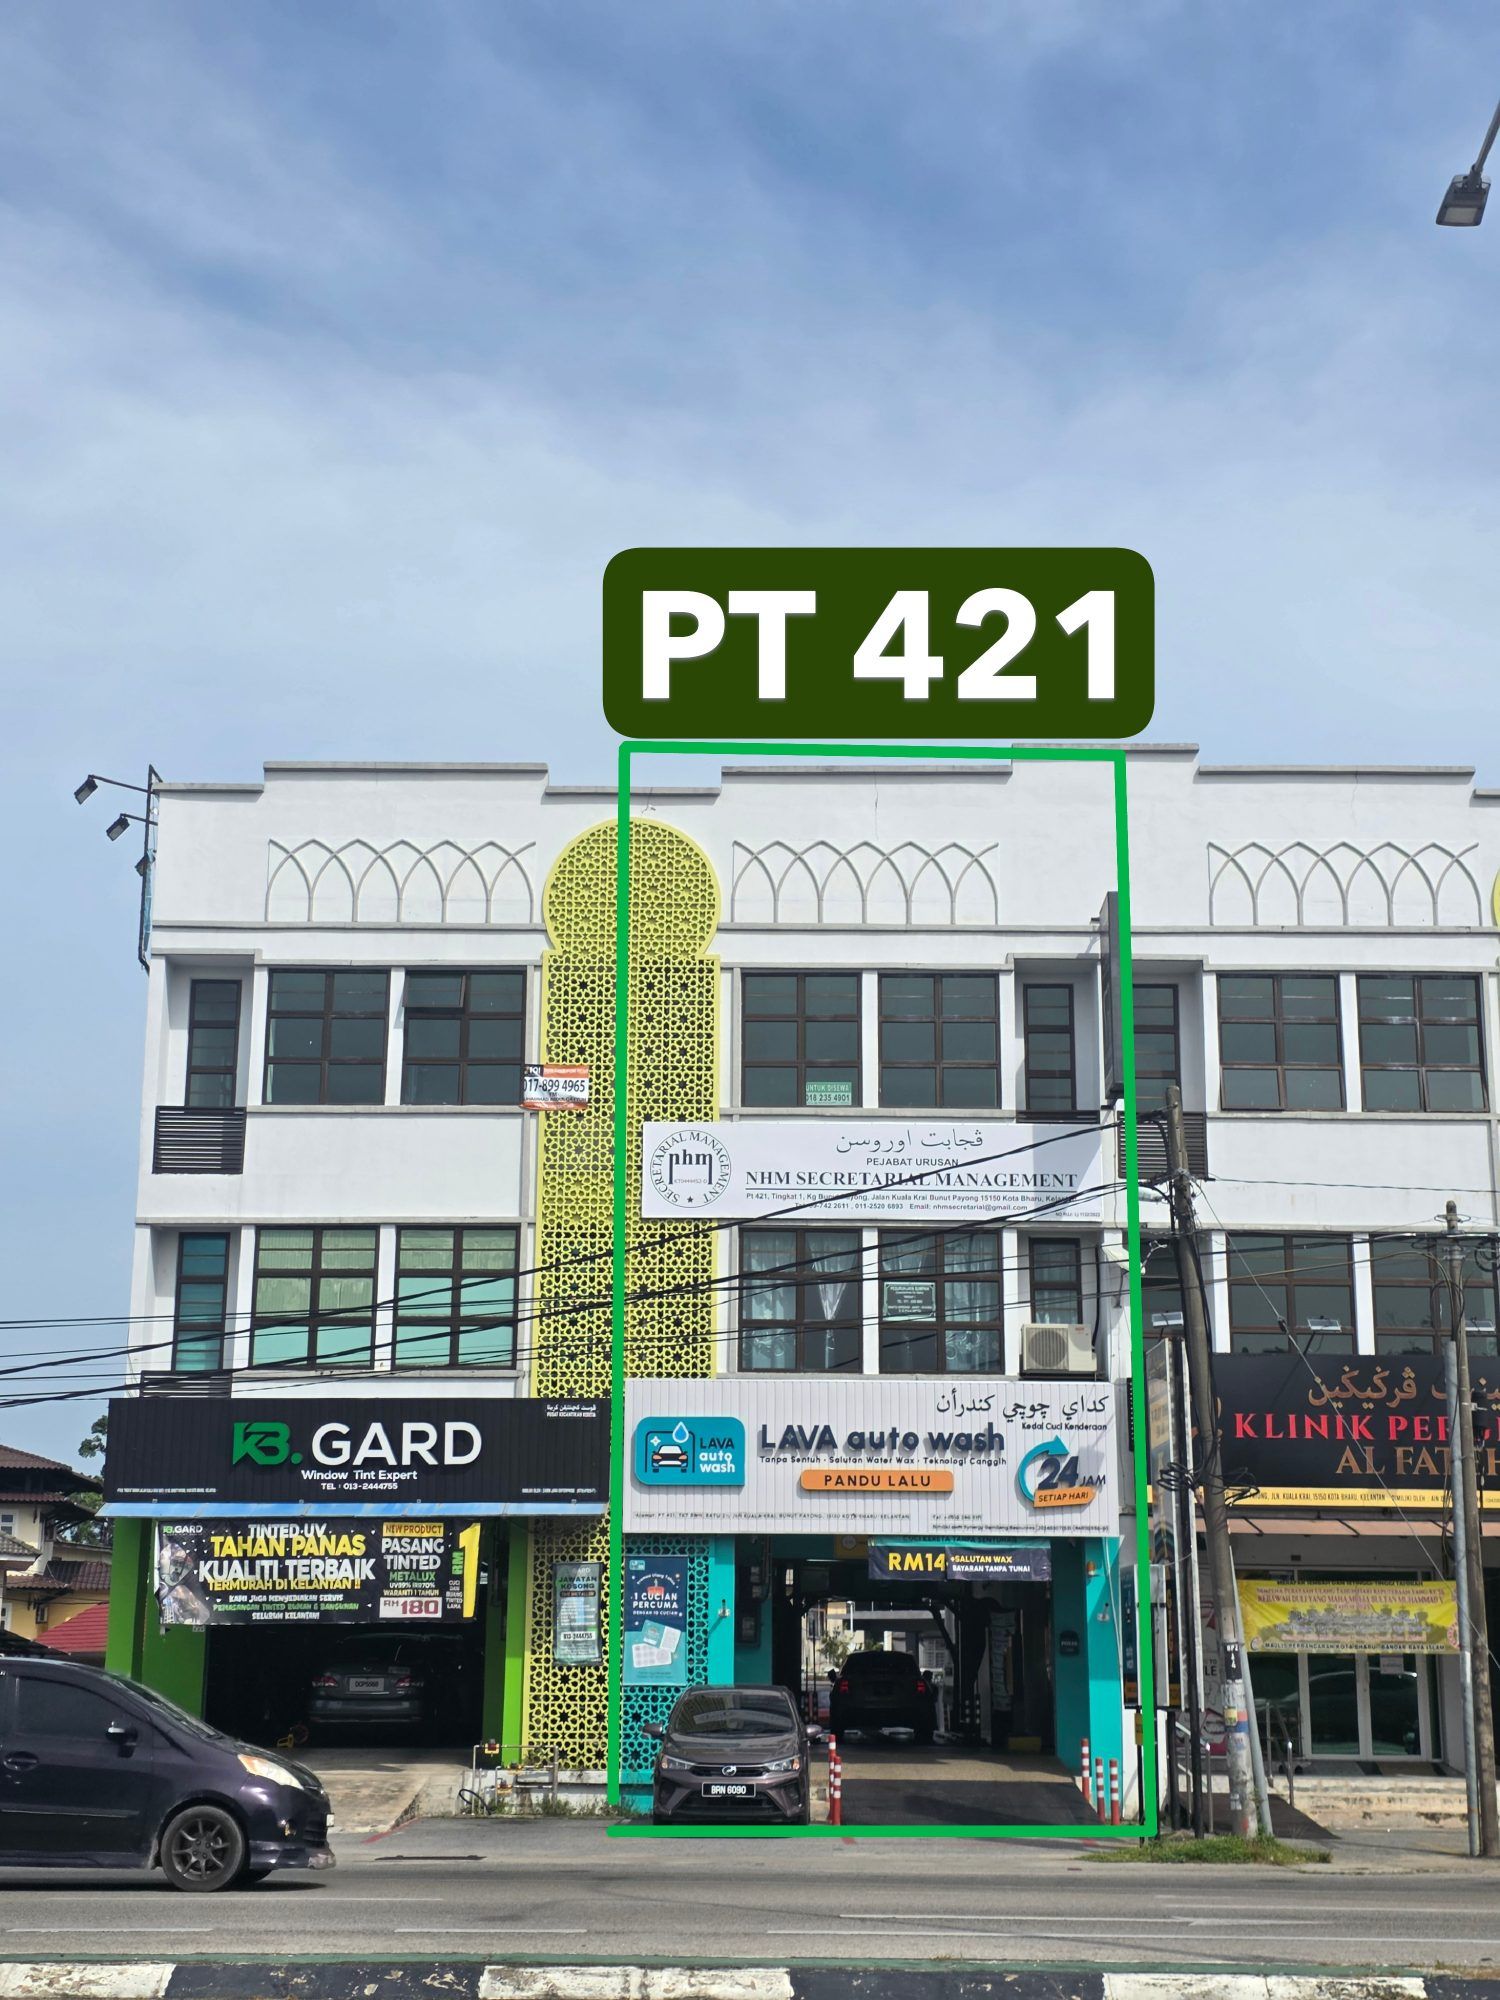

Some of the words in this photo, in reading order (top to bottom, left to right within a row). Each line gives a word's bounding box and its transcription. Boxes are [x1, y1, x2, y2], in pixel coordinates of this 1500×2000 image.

[562, 1080, 586, 1092] 4965
[652, 1132, 687, 1204] SECRETARIAL
[689, 1131, 730, 1204] MANAGEMENT
[866, 1158, 912, 1166] PEJABAT
[916, 1158, 958, 1166] URUSAN
[746, 1172, 790, 1184] NHM
[796, 1172, 930, 1186] SECRETARIAL
[936, 1172, 1078, 1188] MANAGEMENT
[772, 1193, 797, 1201] Tingkat
[806, 1194, 816, 1202] Kg
[1062, 1395, 1109, 1420] كداي
[1022, 1422, 1044, 1430] Kedai
[1046, 1422, 1062, 1430] Cuci
[1064, 1422, 1108, 1431] Kenderaan
[1234, 1413, 1375, 1440] KLINIK
[762, 1424, 838, 1450] LAVA
[849, 1427, 920, 1450] auto
[928, 1422, 1005, 1450] wash
[312, 1422, 482, 1466] GARD
[700, 1438, 734, 1450] LAVA
[700, 1450, 732, 1462] auto
[923, 1457, 966, 1466] Teknologi
[970, 1458, 1006, 1467] Canggih
[1335, 1446, 1386, 1476] AL
[700, 1462, 736, 1473] wash
[1037, 1455, 1080, 1490] 24
[300, 1470, 348, 1480] Window
[353, 1470, 376, 1480] Tint
[378, 1470, 418, 1484] Expert
[824, 1475, 880, 1486] PANDU
[888, 1476, 931, 1487] LALU
[1080, 1475, 1106, 1487] JAM
[343, 1482, 398, 1490] 013-2444755
[1038, 1494, 1068, 1503] SETIAP
[1069, 1492, 1089, 1500] HARI
[248, 1524, 300, 1538] TINTED
[304, 1524, 328, 1538] UV
[386, 1526, 402, 1534] NEW
[404, 1525, 442, 1534] PRODUCT
[210, 1536, 286, 1558] TAHAN
[292, 1535, 366, 1556] PANAS
[382, 1538, 444, 1554] PASANG
[383, 1554, 441, 1570] TINTED
[888, 1552, 945, 1572] RM14
[992, 1556, 1012, 1564] WAX
[199, 1560, 279, 1582] KUALITI
[284, 1558, 376, 1580] TERBAIK
[452, 1551, 464, 1574] RM
[458, 1522, 480, 1618] 1
[390, 1572, 436, 1582] METALUX
[208, 1580, 272, 1591] TERMURAH
[276, 1580, 288, 1590] DI
[292, 1578, 352, 1590] KELANTAN
[229, 1594, 247, 1602] KAMI
[249, 1594, 266, 1602] JUGA
[268, 1594, 318, 1602] MENYEDIAKAN
[641, 1592, 678, 1600] CUCIAN
[400, 1600, 439, 1614] 180
[252, 1612, 283, 1620] SELURUH
